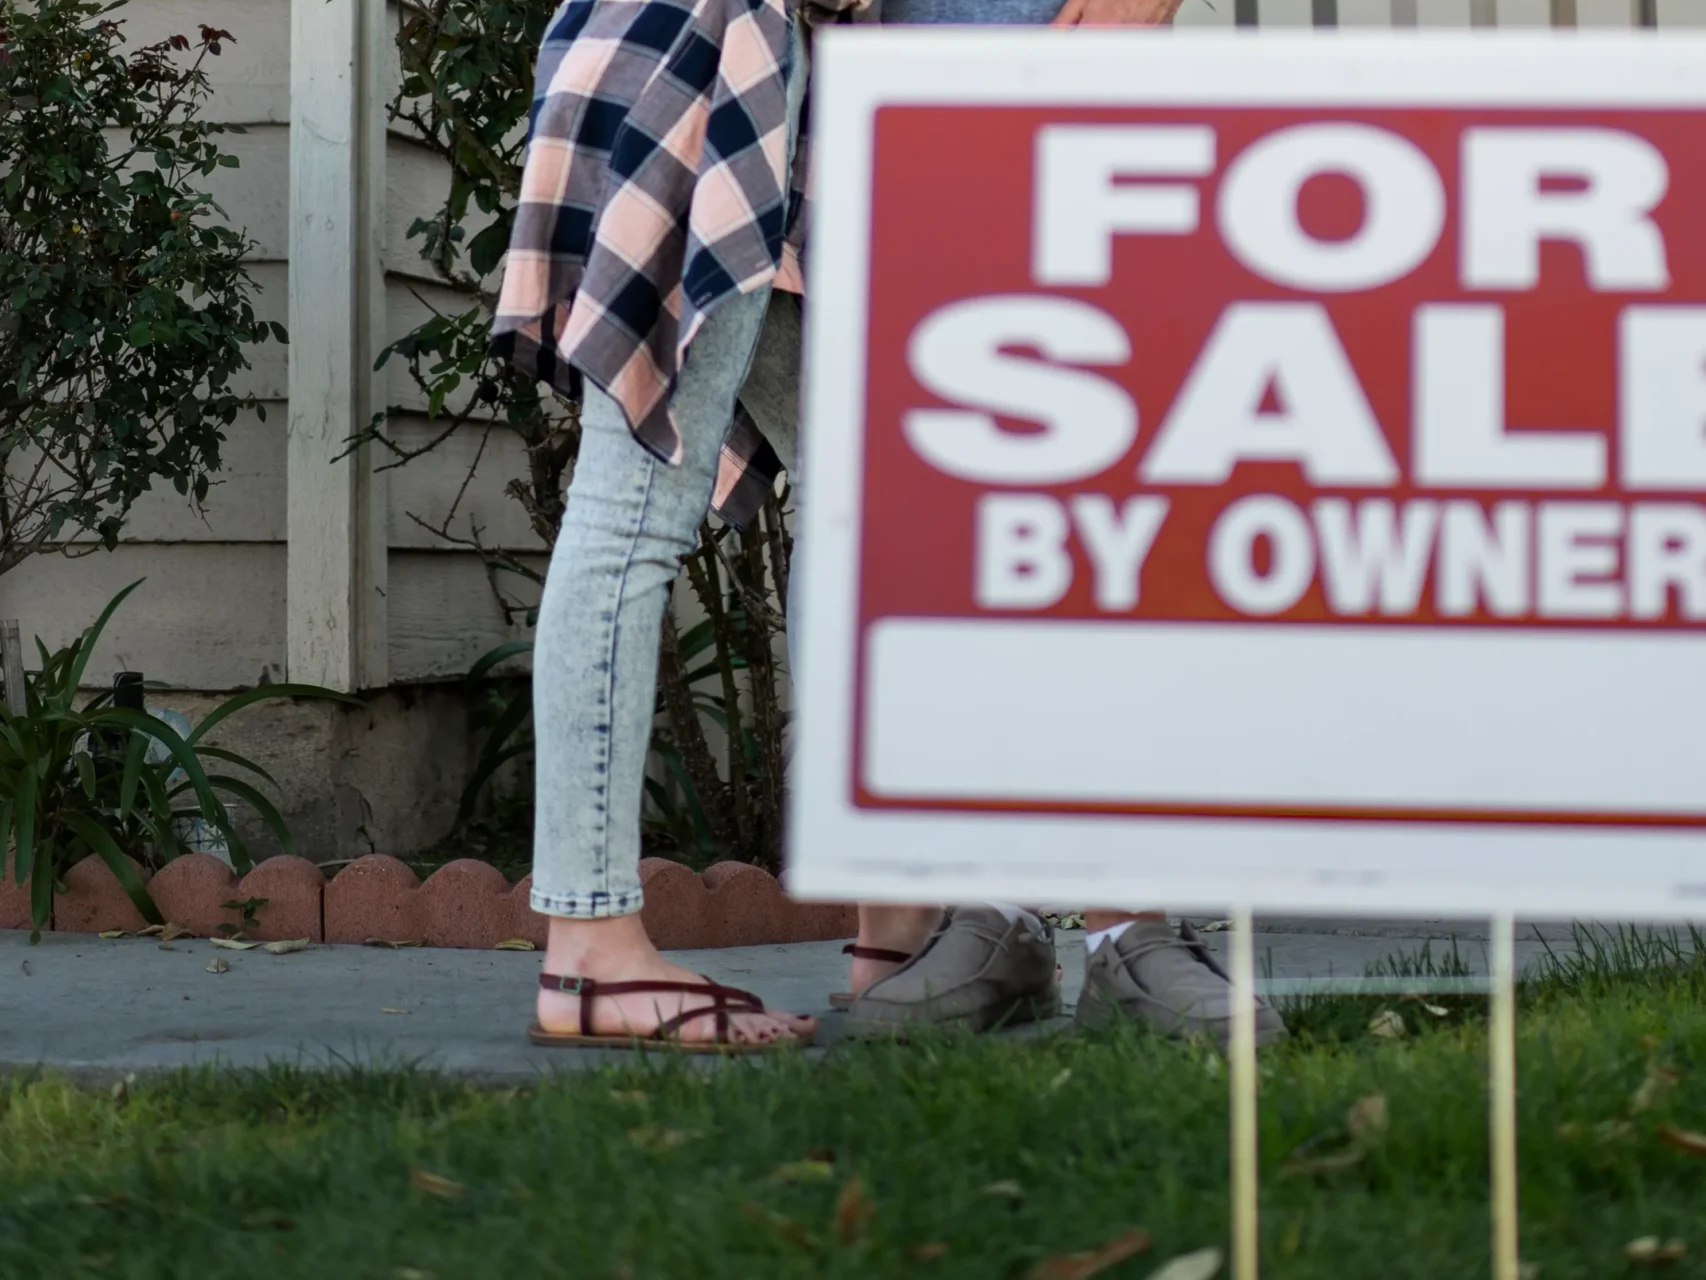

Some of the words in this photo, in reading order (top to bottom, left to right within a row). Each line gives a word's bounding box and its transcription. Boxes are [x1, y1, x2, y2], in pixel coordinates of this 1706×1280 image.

[1032, 122, 1671, 293] FOR
[975, 493, 1169, 613] BY
[1208, 493, 1706, 620] OWNER
